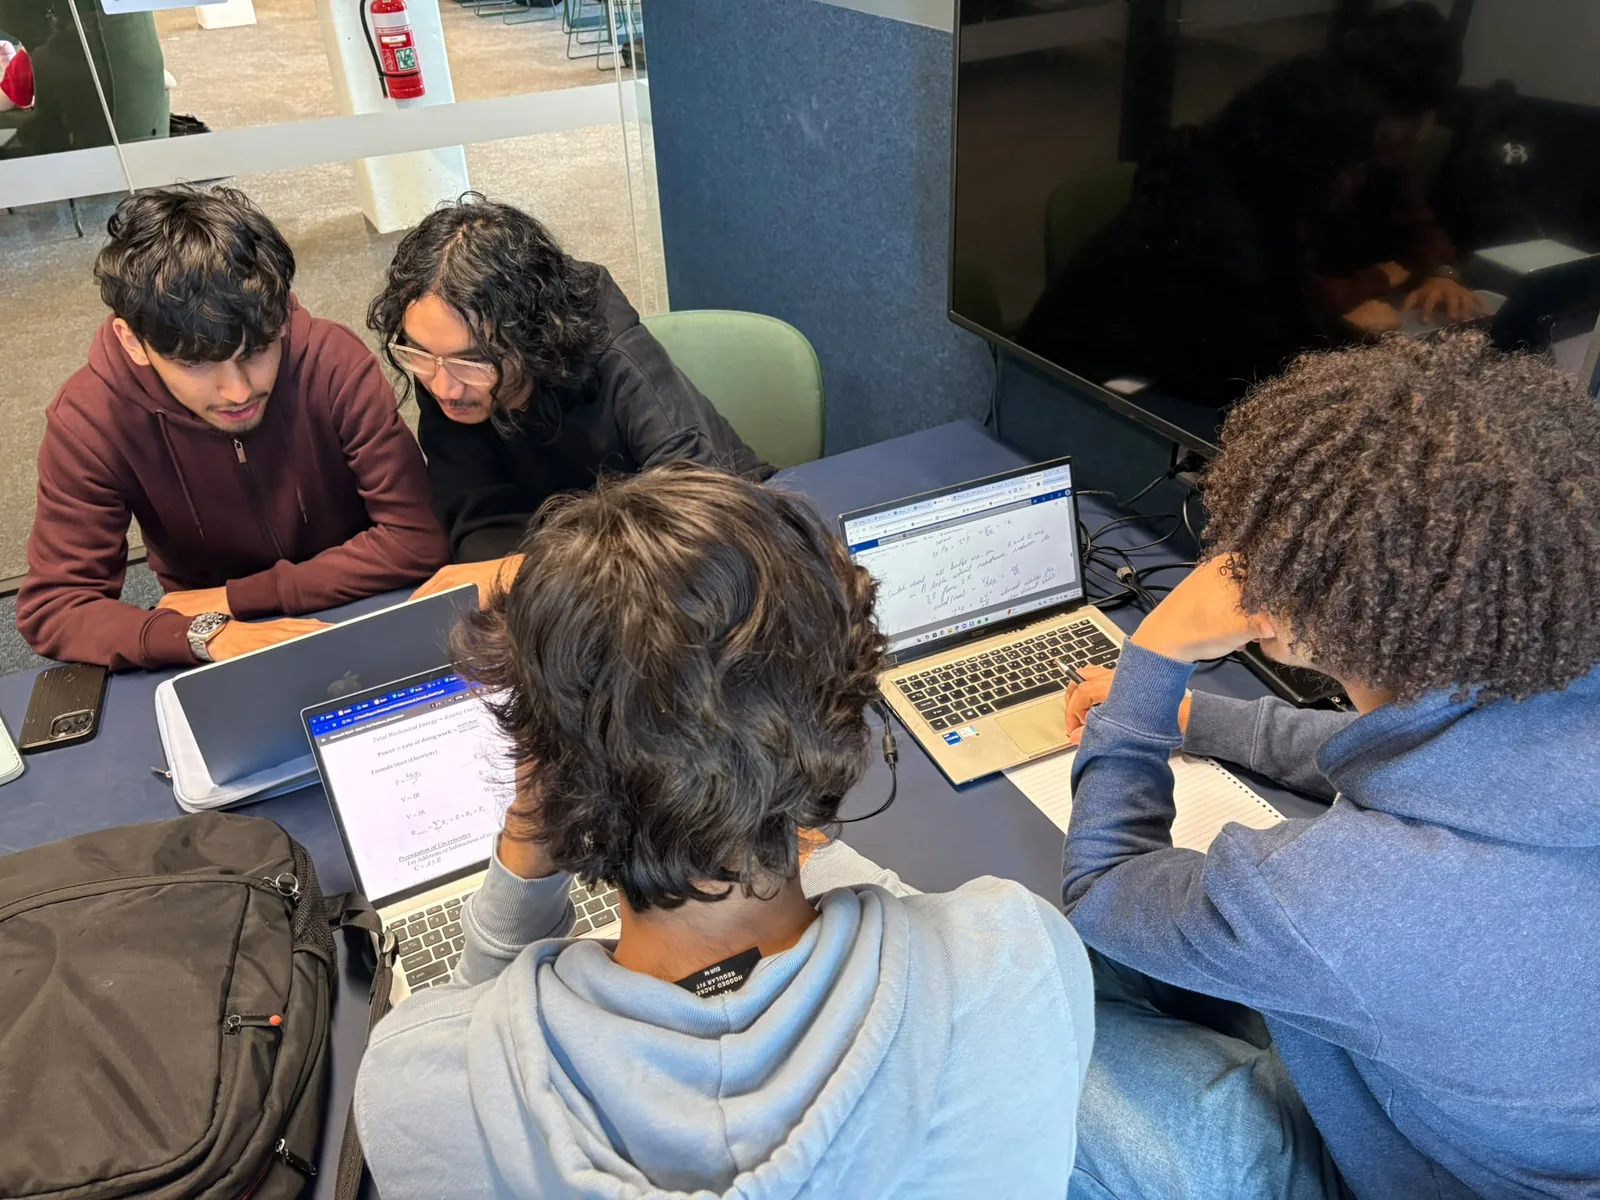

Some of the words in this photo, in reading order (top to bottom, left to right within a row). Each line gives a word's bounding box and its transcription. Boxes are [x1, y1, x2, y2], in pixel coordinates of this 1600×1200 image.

[710, 966, 721, 974] EUR
[707, 970, 736, 985] REGULAR
[717, 974, 743, 989] HOODED
[696, 982, 706, 990] FIT
